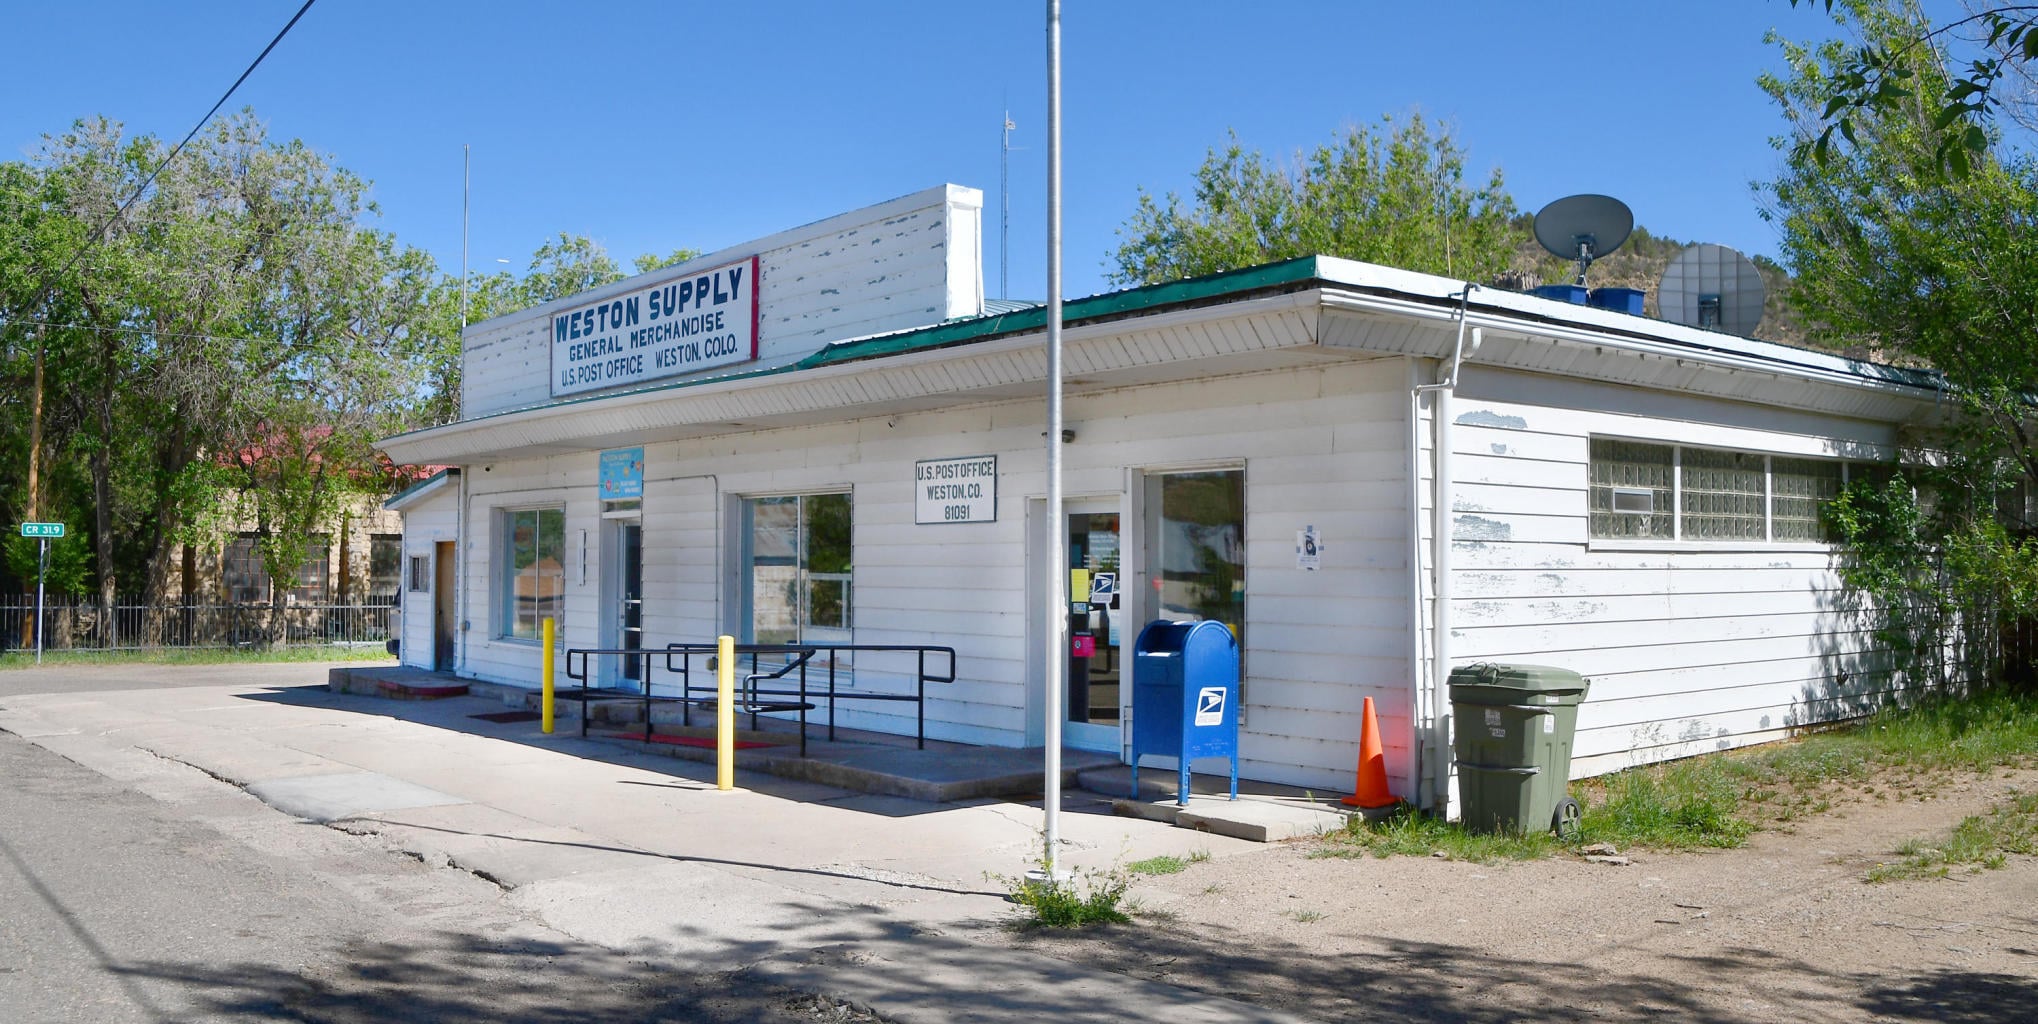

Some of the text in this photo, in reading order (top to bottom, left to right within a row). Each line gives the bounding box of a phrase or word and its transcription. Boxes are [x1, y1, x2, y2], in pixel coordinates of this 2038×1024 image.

[556, 267, 743, 343] WESTON SUPPLY
[569, 310, 724, 361] GENERAL MERCHANDISE
[561, 368, 576, 387] U.S.
[578, 362, 603, 384] POST
[606, 354, 643, 379] OFFICE
[704, 333, 738, 359] COLO.
[917, 466, 934, 480] U.S.
[944, 504, 970, 520] 81091
[25, 525, 60, 534] CR 31.9
